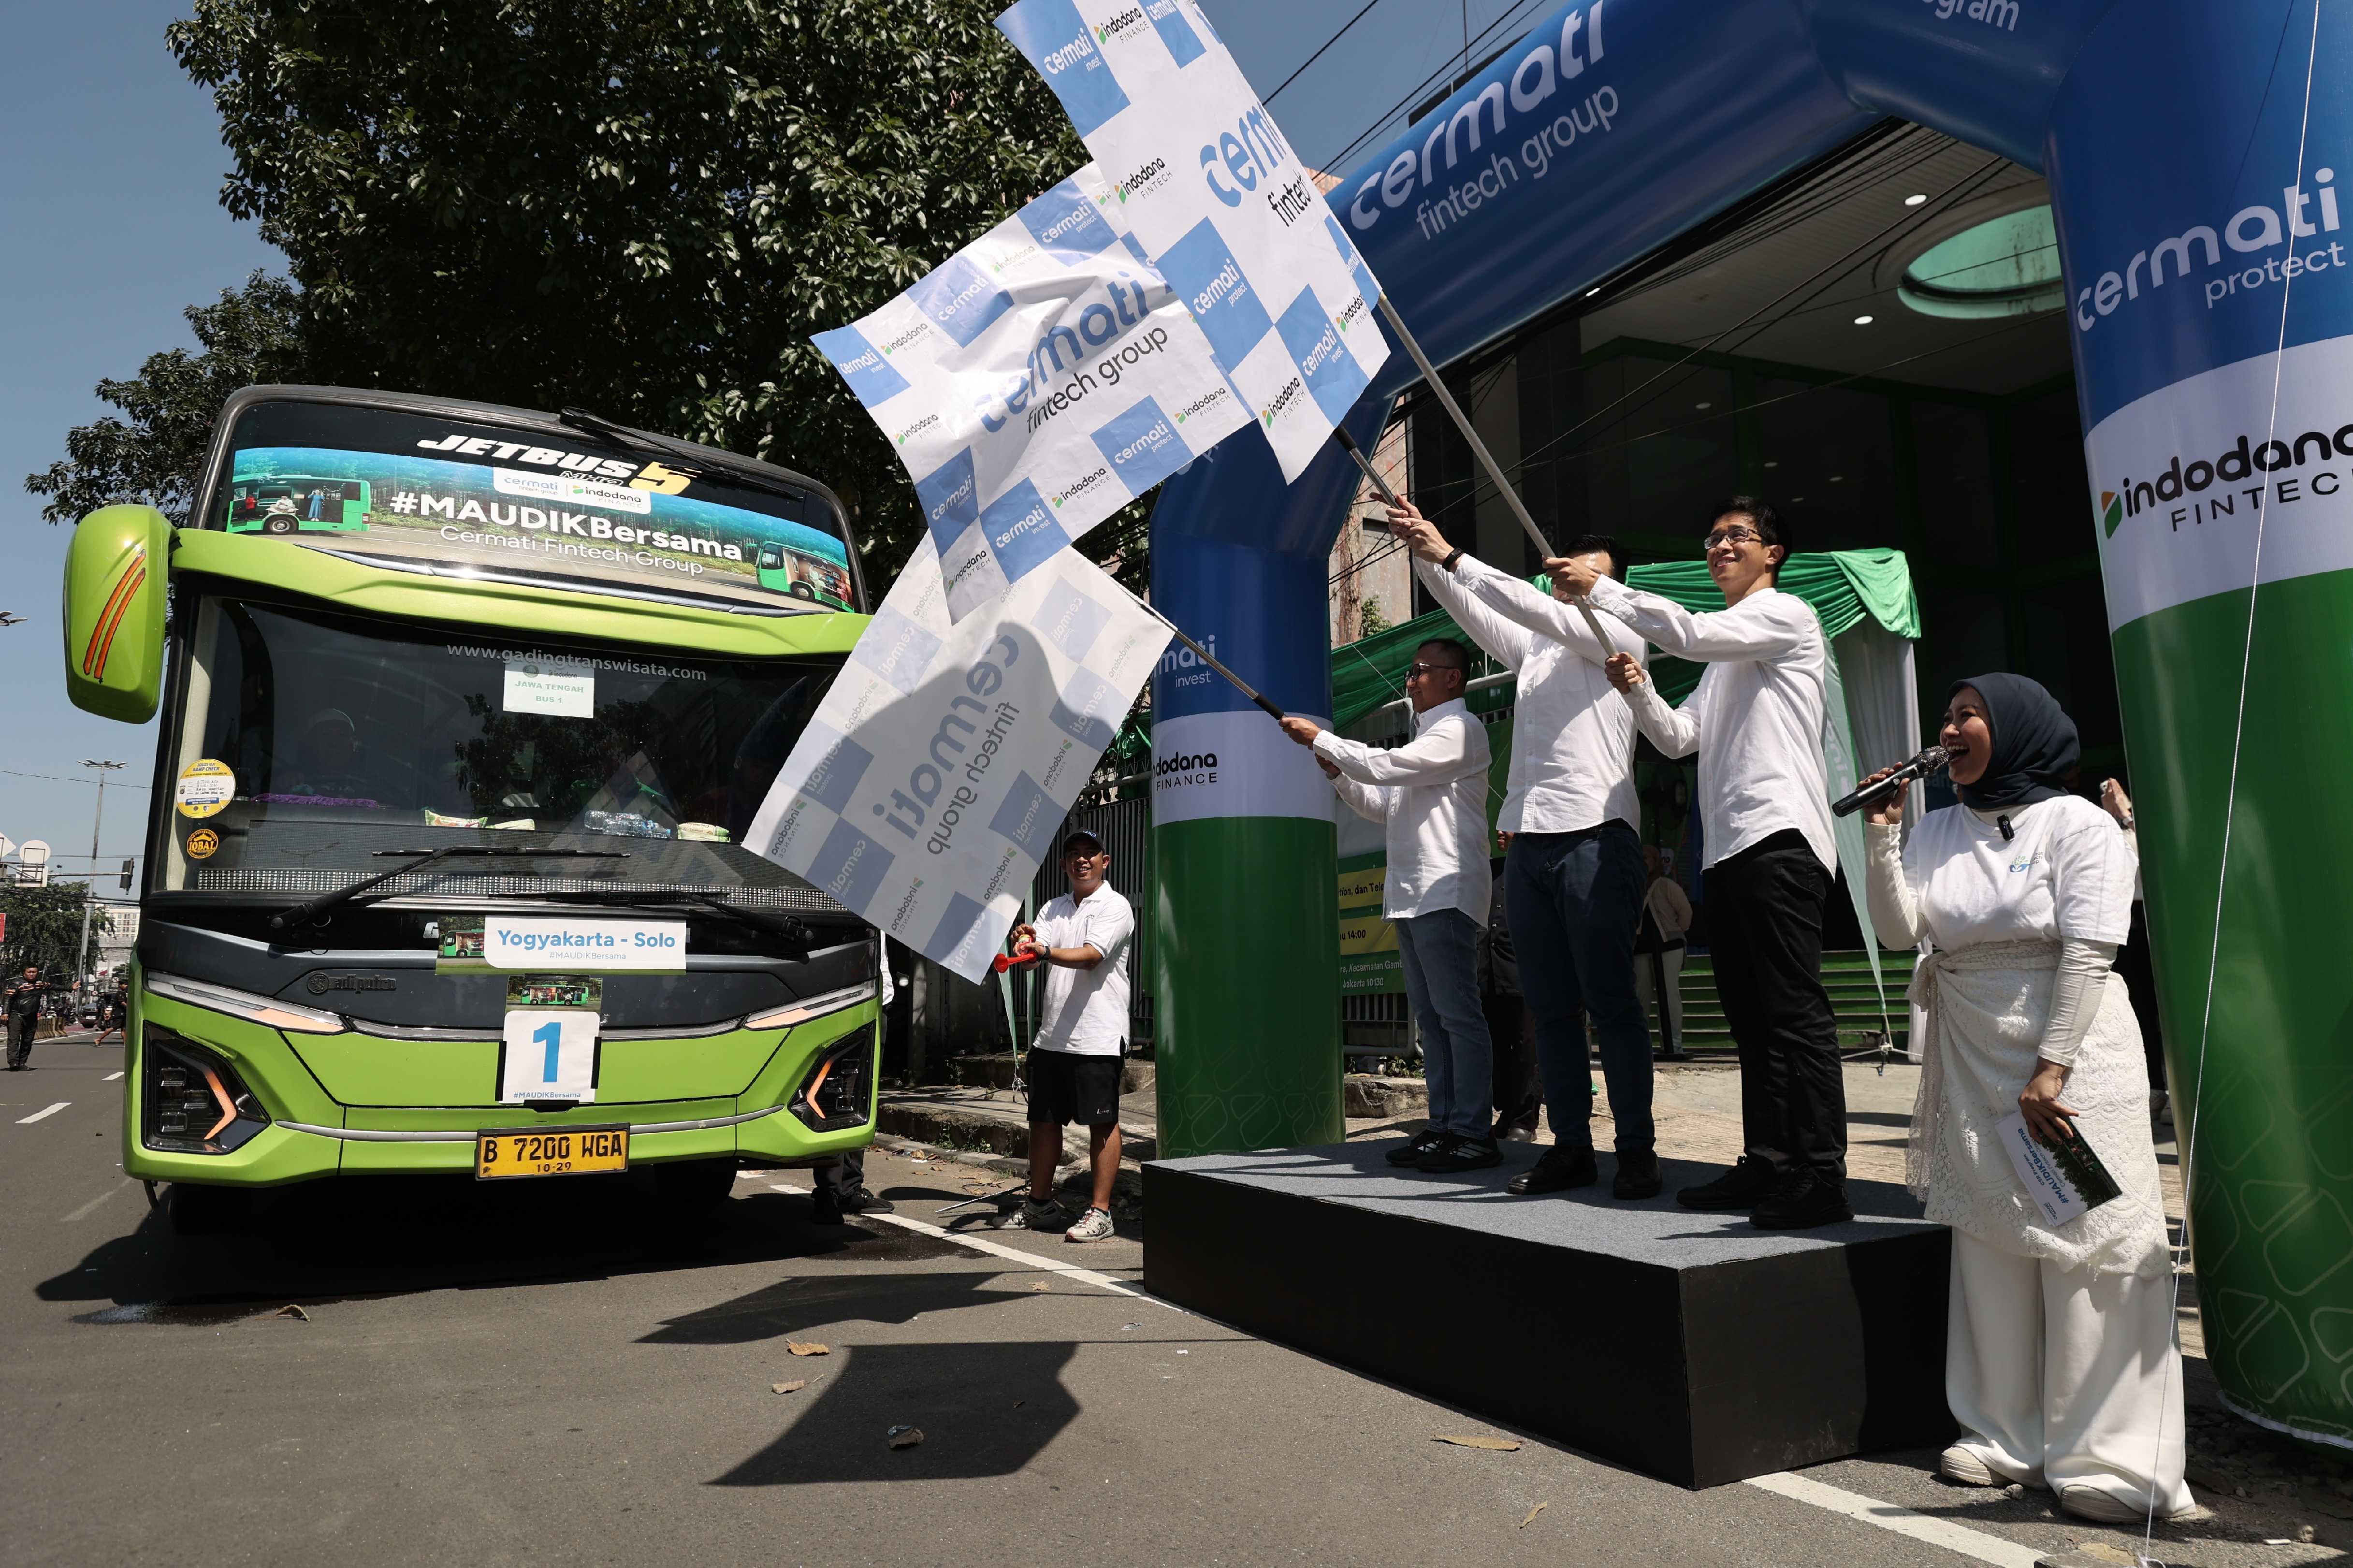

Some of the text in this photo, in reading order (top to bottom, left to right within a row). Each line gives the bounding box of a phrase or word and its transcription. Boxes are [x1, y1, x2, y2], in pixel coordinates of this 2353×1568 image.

[1101, 8, 1142, 37] indodana
[1119, 21, 1149, 44] FINANCE
[1044, 28, 1094, 74] cermati
[1084, 55, 1102, 72] invest
[1350, 3, 1604, 230] cermati
[1200, 101, 1287, 208] cerm
[1416, 86, 1619, 240] fintech group
[1120, 157, 1165, 195] indodana
[1141, 170, 1173, 200] FINTECH
[1041, 201, 1092, 244] cermati
[1076, 215, 1097, 234] protect
[2077, 168, 2339, 332] cermati
[1193, 258, 1240, 315] cermati
[2205, 241, 2347, 309] protect
[938, 273, 990, 321] cermati
[1228, 282, 1248, 307] protect
[887, 322, 928, 350] indodana
[903, 329, 935, 352] FINANCE
[1302, 323, 1337, 377] cermati
[839, 348, 879, 375] cermati
[973, 270, 1150, 433] cermati
[1330, 347, 1344, 364] invest
[1026, 327, 1168, 433] fintech group
[1183, 388, 1226, 417] indodana
[1199, 395, 1231, 417] FINTECH
[1268, 377, 1300, 417] indodana
[1283, 390, 1306, 420] FINTECH
[901, 414, 939, 438] indodana
[1115, 420, 1169, 464] cermati
[1152, 434, 1174, 452] protect
[417, 434, 639, 479] JETBUS
[504, 477, 558, 491] cermati
[518, 485, 541, 494] fintech
[583, 486, 642, 503] indodana
[931, 474, 972, 521] cermati
[1060, 467, 1107, 501] indodana
[1076, 475, 1111, 500] FINANCE
[598, 497, 642, 508] FINANCE
[2171, 468, 2353, 532] FINTEC
[389, 490, 742, 562] #MAUDIKBersama
[995, 504, 1046, 548] cermati
[1031, 519, 1051, 534] invest
[440, 525, 703, 577] Cermati Fintech Group
[953, 550, 987, 583] indodana
[962, 558, 990, 582] FINTECH
[447, 644, 707, 681] www.gadingtranswisata.com
[554, 670, 578, 679] indodana
[515, 681, 584, 693] JAWA TENGAH
[1175, 670, 1211, 688] invest
[1151, 752, 1217, 779] ndodana
[1156, 772, 1217, 791] FINANCE
[189, 841, 216, 853] IQBAL
[1338, 881, 1384, 898] tion, dan Tele
[497, 929, 614, 950] Yogyakarta
[634, 932, 675, 948] Solo
[1348, 929, 1366, 939] 14:00
[549, 951, 626, 960] #MAUDIKBersama
[1349, 962, 1383, 972] Kecamatan
[1342, 977, 1384, 988] Jakarta 10130
[533, 1022, 562, 1083] 1
[483, 1134, 623, 1163] B 7200 WGA
[536, 1161, 572, 1173] 10-29
[2018, 1128, 2069, 1204] #MAUDIKBersama
